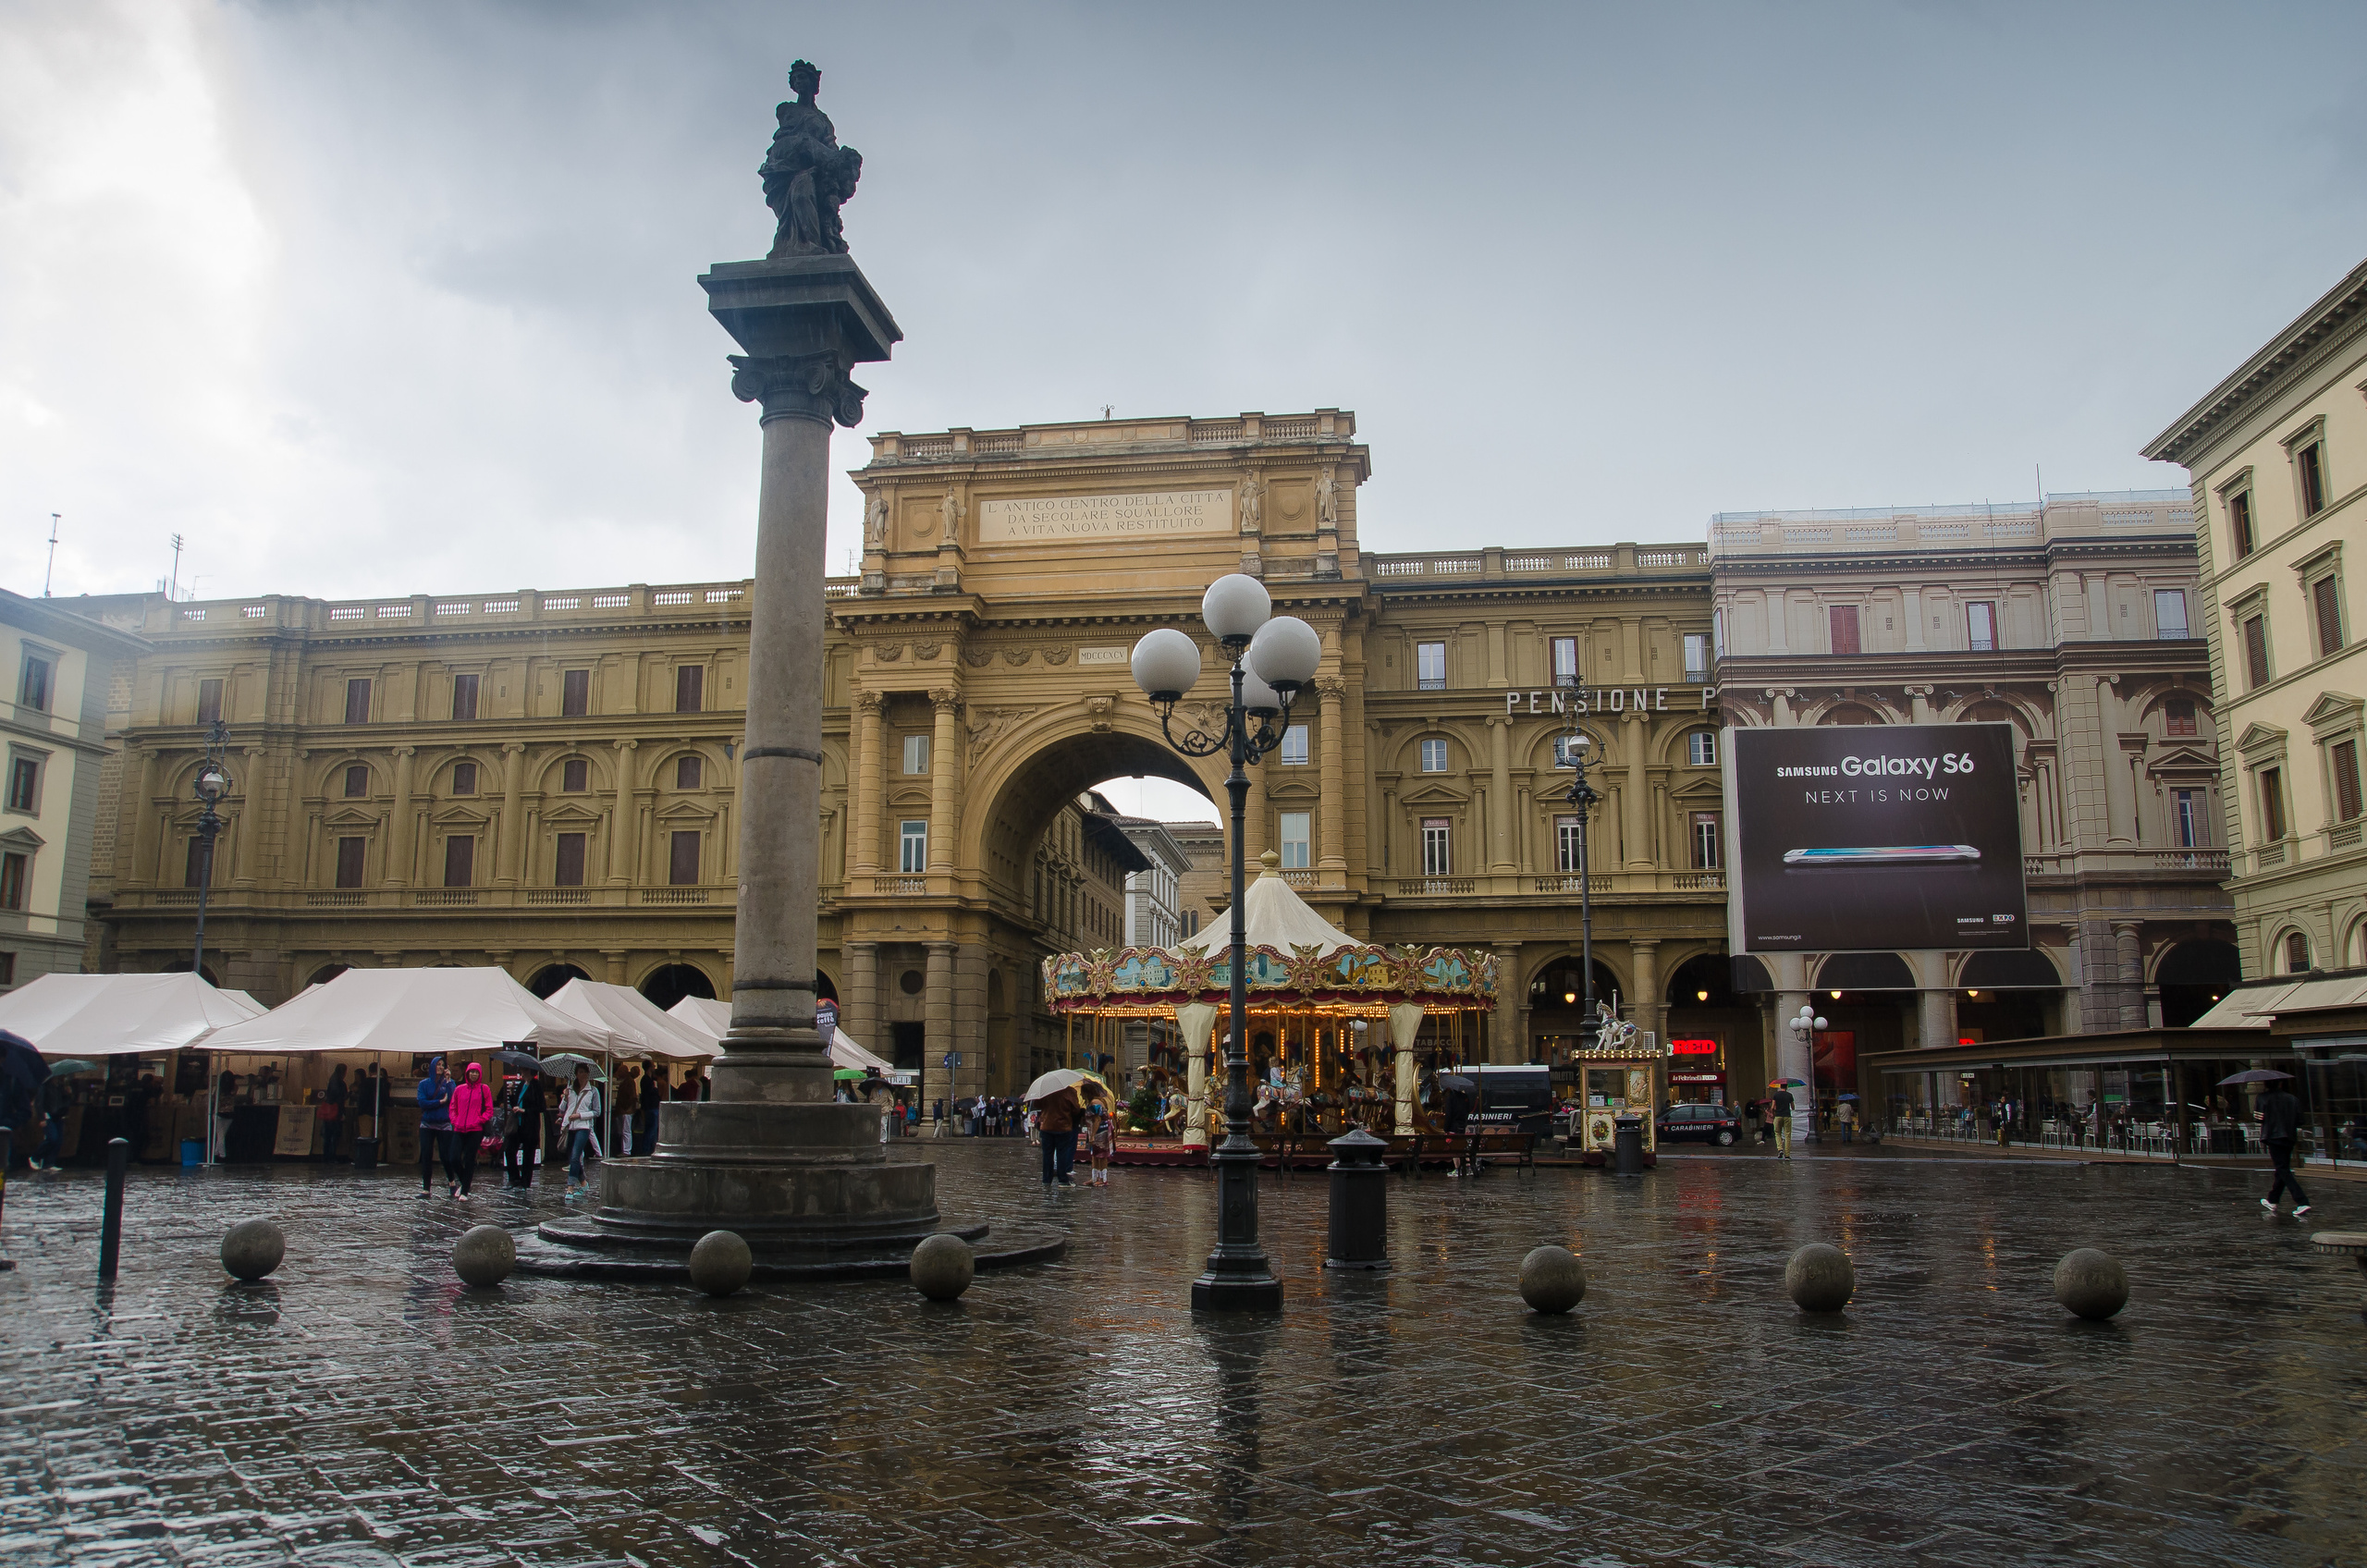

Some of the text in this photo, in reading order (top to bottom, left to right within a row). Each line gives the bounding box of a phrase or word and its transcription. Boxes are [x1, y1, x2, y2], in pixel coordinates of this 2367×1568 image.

[1004, 500, 1055, 512] ANTICO
[1061, 497, 1120, 509] CENTRO
[1125, 495, 1173, 507] DELLA
[1008, 505, 1203, 524] DA SECOLARE SQUALLORE
[1008, 518, 1204, 536] A VITA NUOVA RESTITUITO
[1081, 651, 1124, 660] MDCCCXCV
[1506, 687, 1669, 715] PENSIONE
[1776, 753, 1975, 780] SAMSUNG Galaxy S6
[1805, 788, 1950, 804] NEXT IS NOW
[1672, 1040, 1717, 1054] RED
